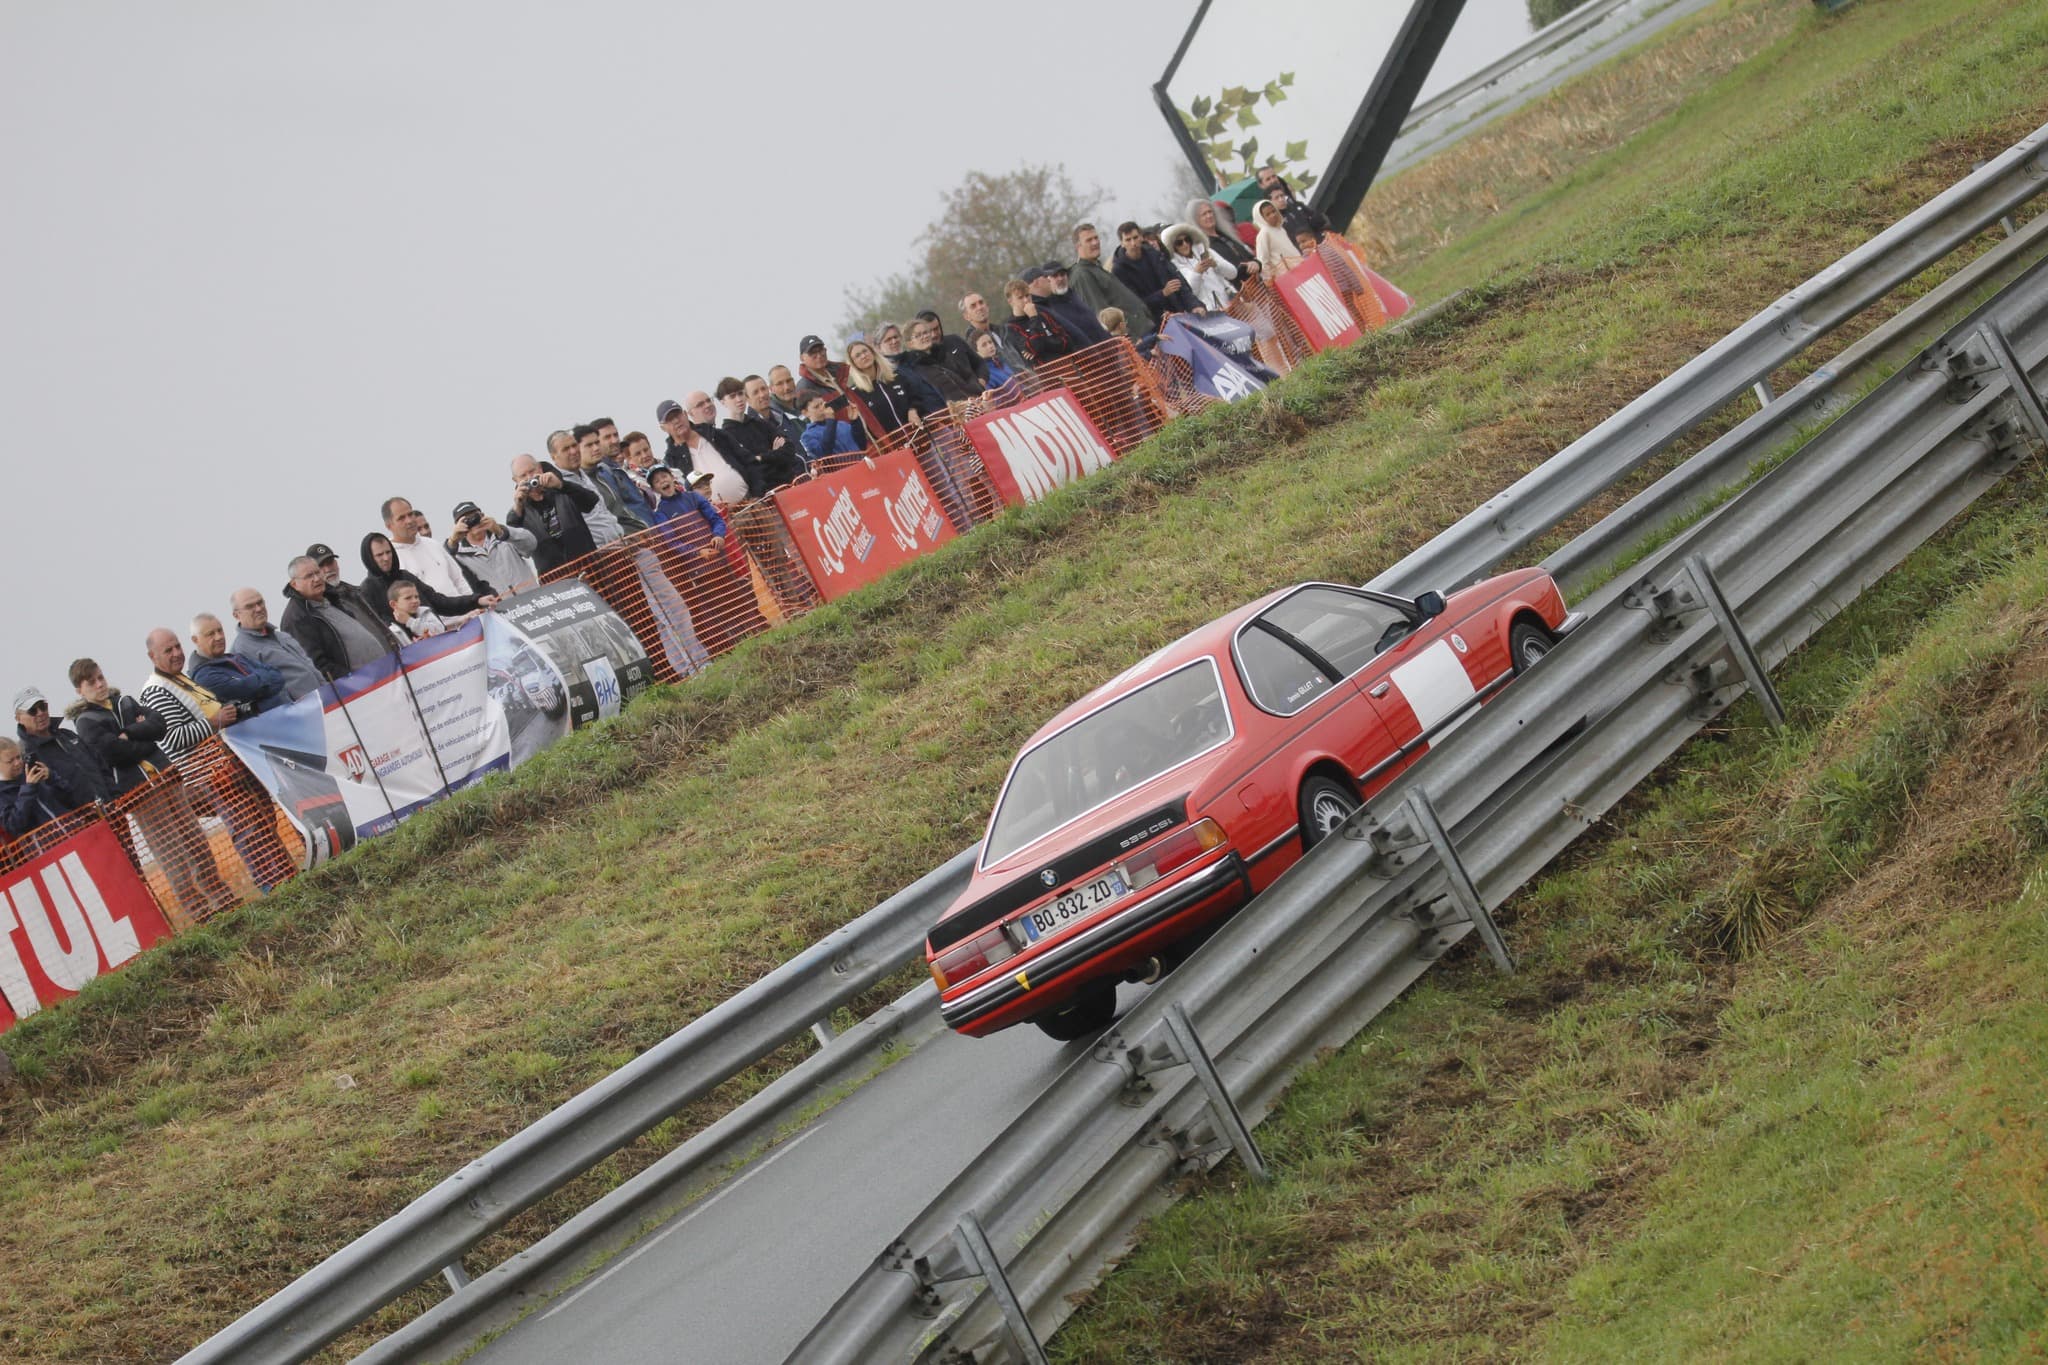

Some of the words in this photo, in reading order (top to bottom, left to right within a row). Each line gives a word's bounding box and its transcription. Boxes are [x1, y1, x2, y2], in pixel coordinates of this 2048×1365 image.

[985, 396, 1112, 505] MOTUL
[812, 485, 861, 574] Courrier
[883, 468, 929, 550] Courrier
[1120, 830, 1148, 848] 635
[1033, 880, 1111, 932] BQ-832-ZD
